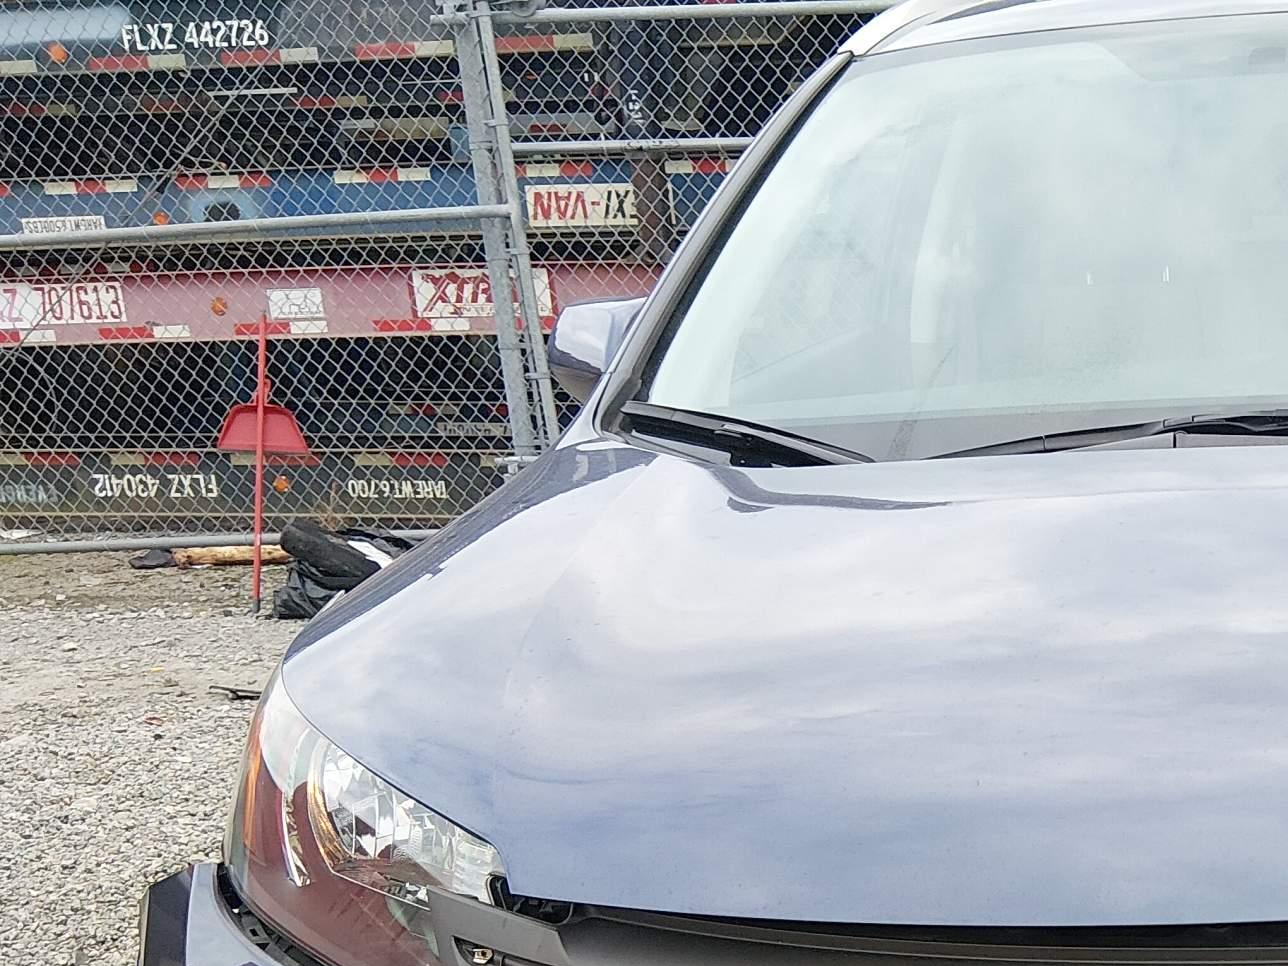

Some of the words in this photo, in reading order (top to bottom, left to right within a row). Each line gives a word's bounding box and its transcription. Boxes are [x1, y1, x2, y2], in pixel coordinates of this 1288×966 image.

[121, 23, 178, 51] FLXZ
[185, 20, 269, 48] 442726
[32, 284, 122, 321] 707613
[92, 475, 159, 497] 430412
[167, 474, 219, 498] FLXZ
